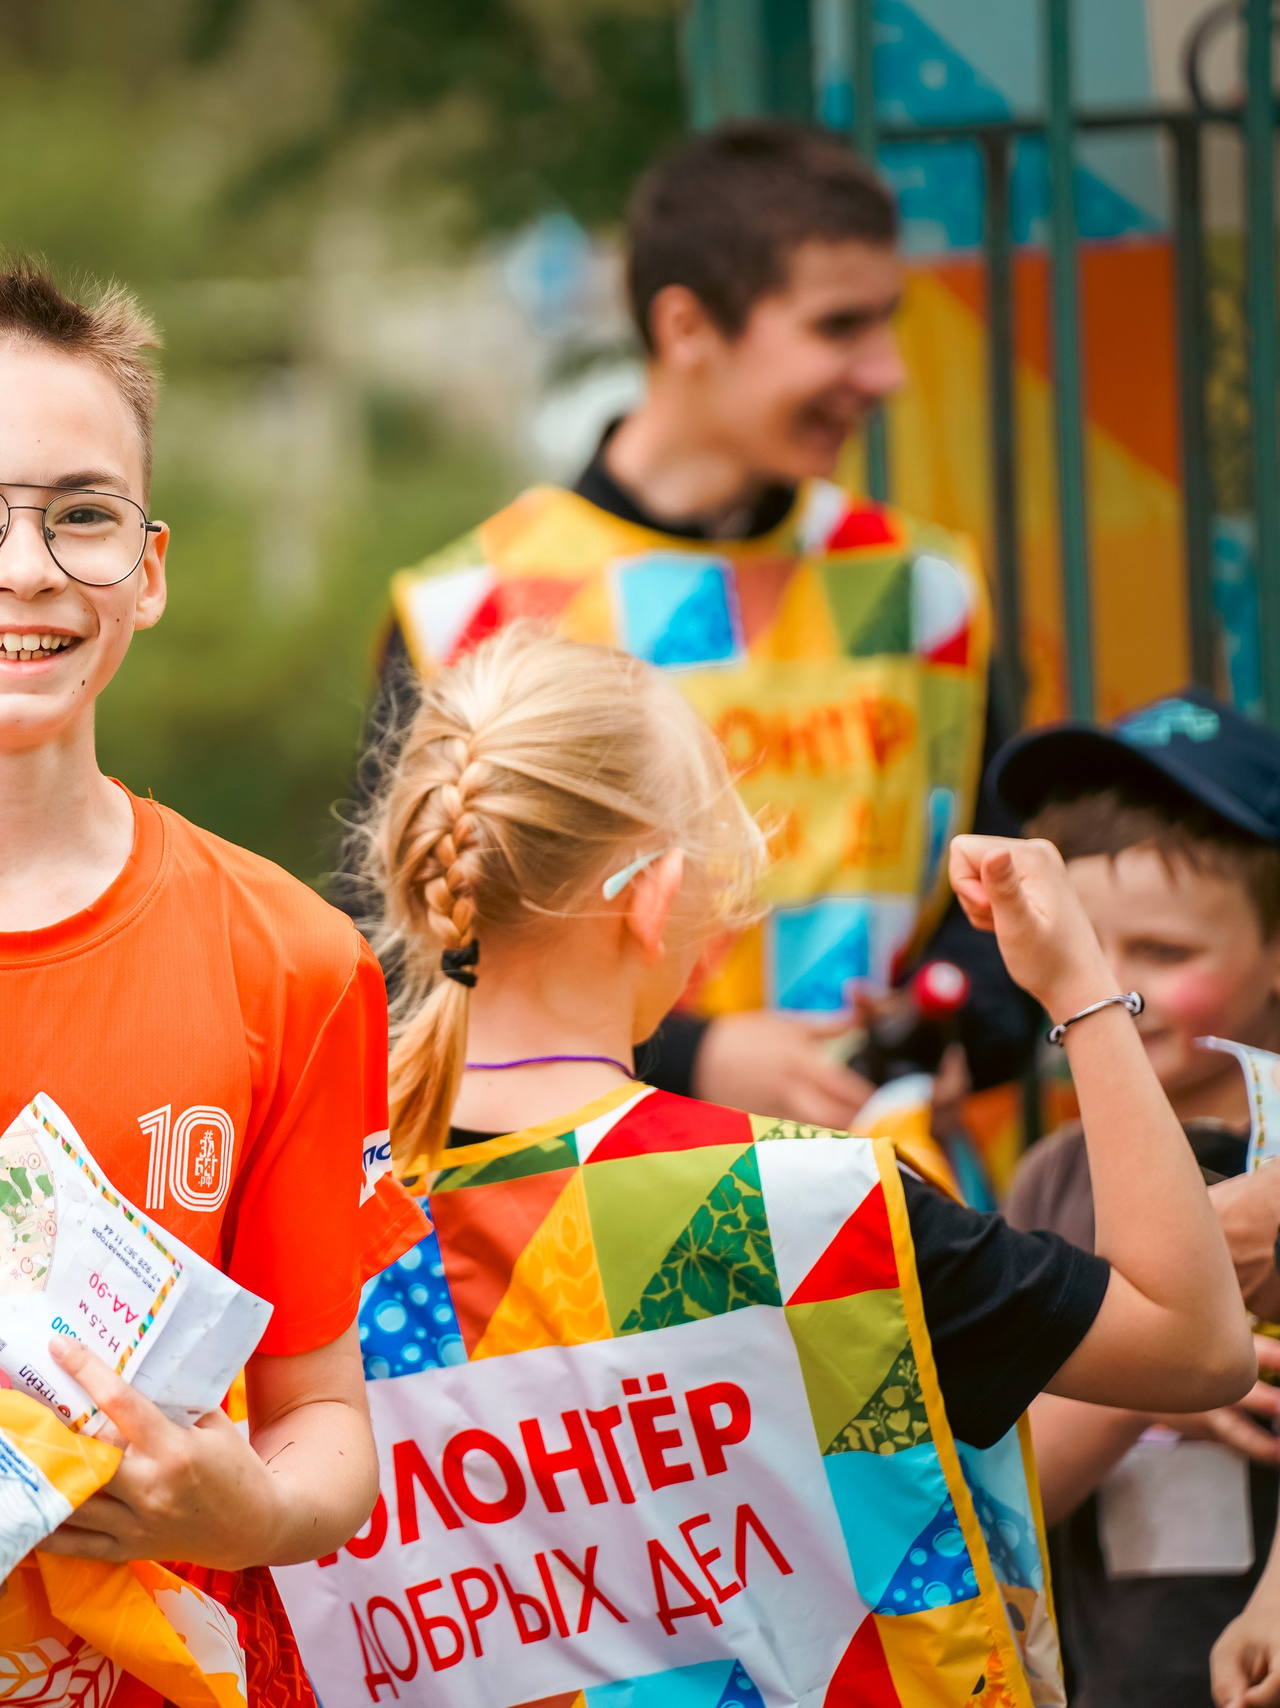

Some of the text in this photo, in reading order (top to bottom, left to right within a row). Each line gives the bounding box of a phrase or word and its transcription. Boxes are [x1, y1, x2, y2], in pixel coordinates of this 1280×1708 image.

[137, 1103, 235, 1213] 10
[89, 1273, 139, 1324] АА-90
[89, 1314, 108, 1339] 2,5
[317, 1373, 752, 1568] ЛОНТЁР
[350, 1503, 794, 1703] ДОБРЫХ ДЕЛ
